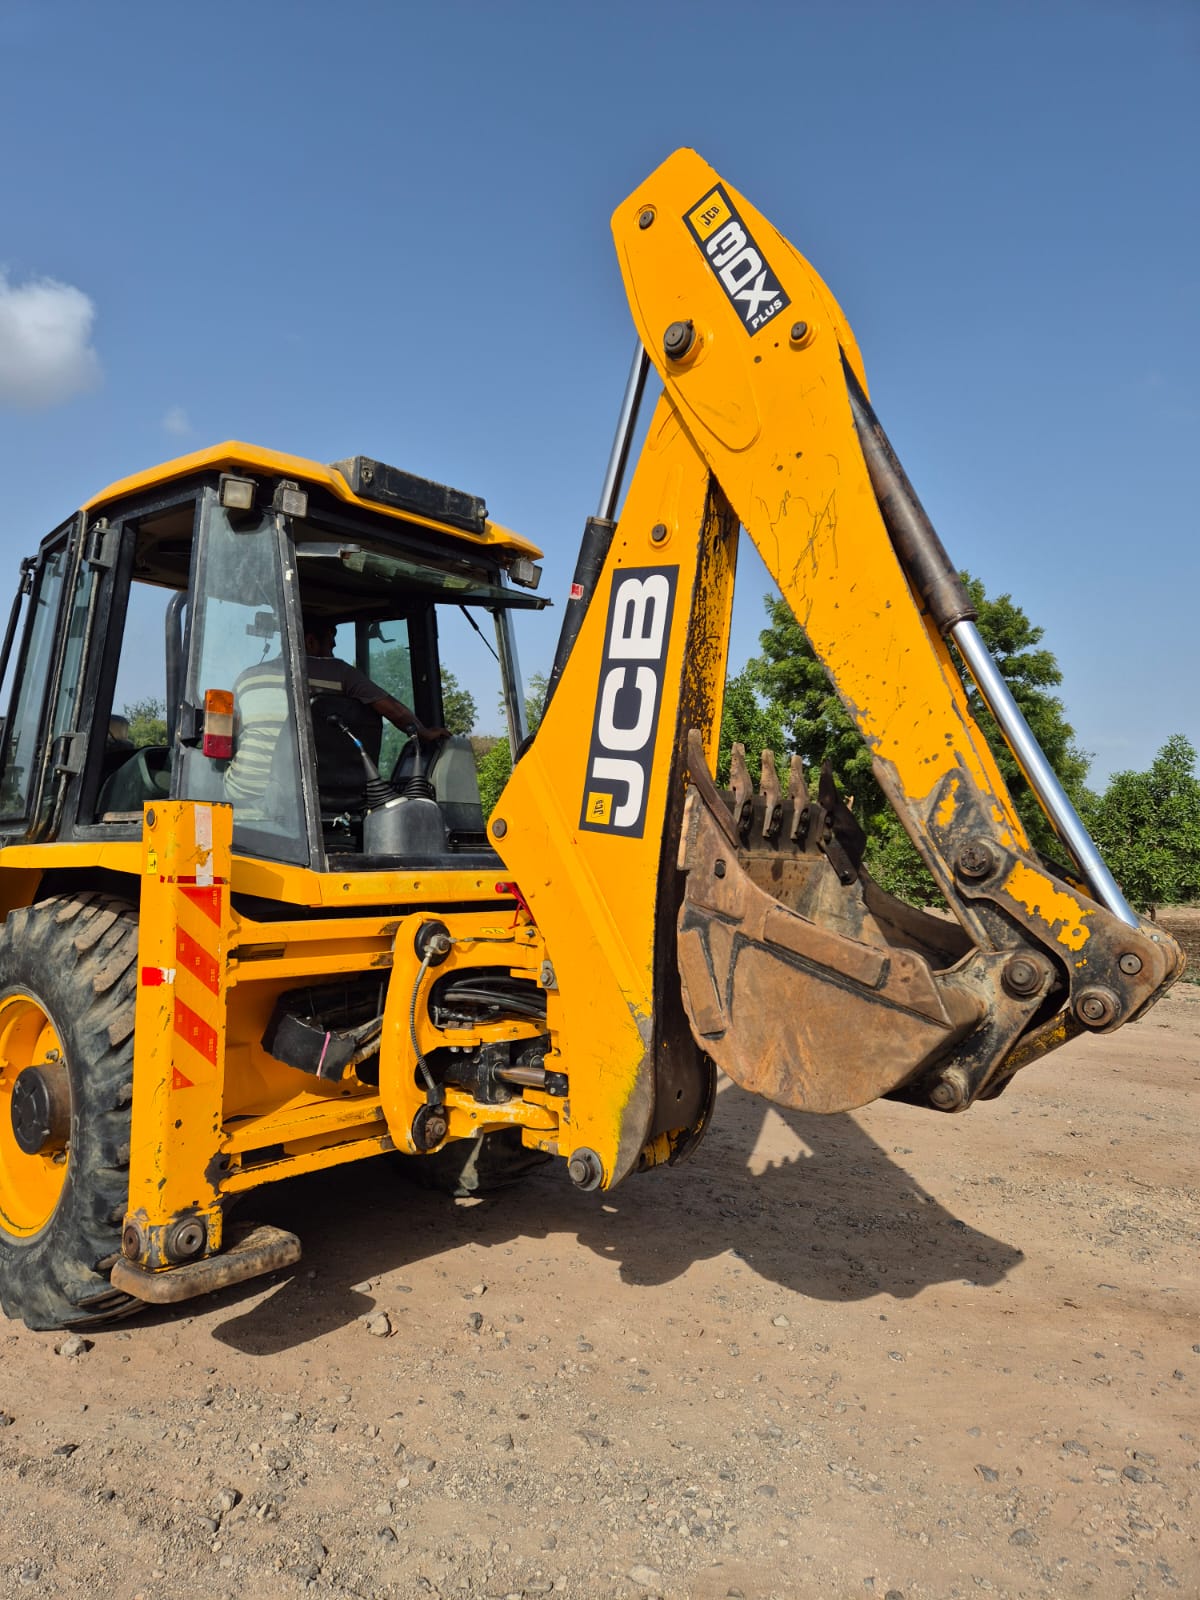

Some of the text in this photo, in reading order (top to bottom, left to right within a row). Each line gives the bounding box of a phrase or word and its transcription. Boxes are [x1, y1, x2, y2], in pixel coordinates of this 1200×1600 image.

[700, 206, 721, 226] JCB
[706, 221, 781, 321] 3DX
[751, 299, 783, 329] PLUS
[592, 574, 670, 828] JCB
